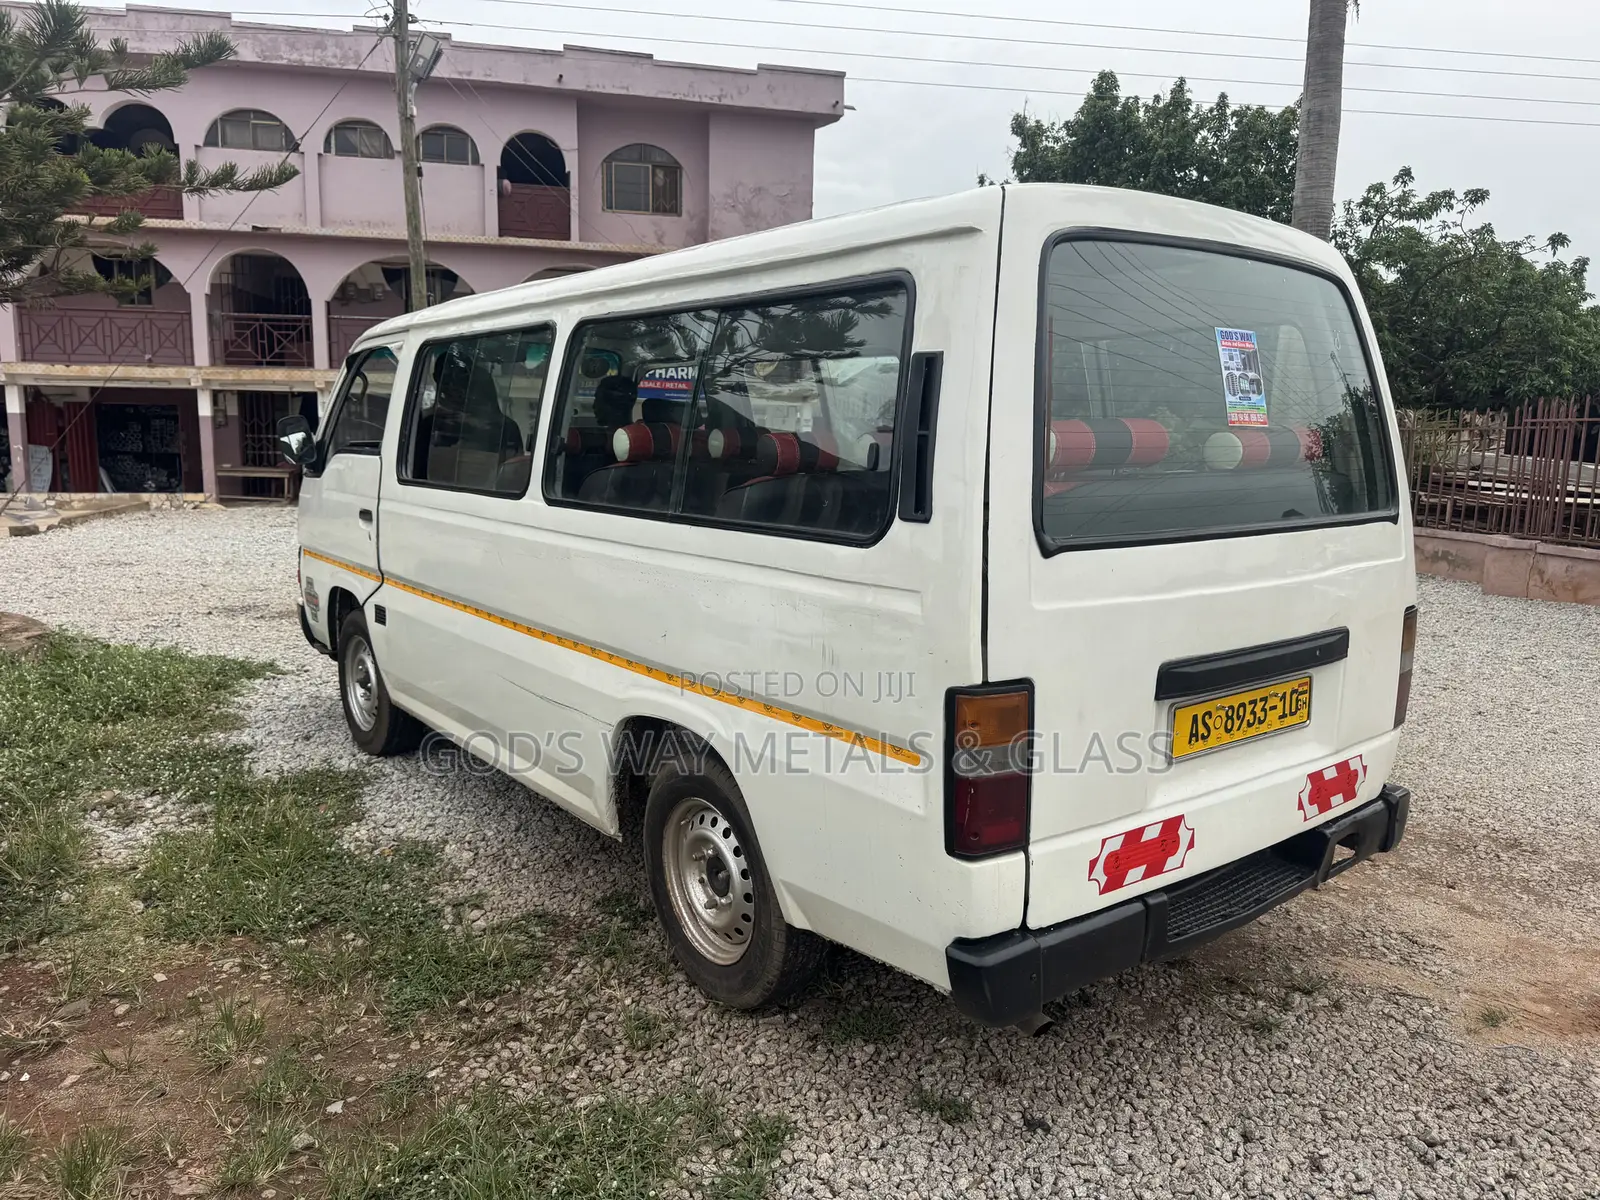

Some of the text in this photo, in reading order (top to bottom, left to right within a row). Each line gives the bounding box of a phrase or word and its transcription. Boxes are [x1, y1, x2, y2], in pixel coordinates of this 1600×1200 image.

[1220, 330, 1239, 341] GOD'S
[638, 380, 661, 389] ESALE
[665, 382, 688, 390] RETAIL
[1188, 710, 1213, 745] AS
